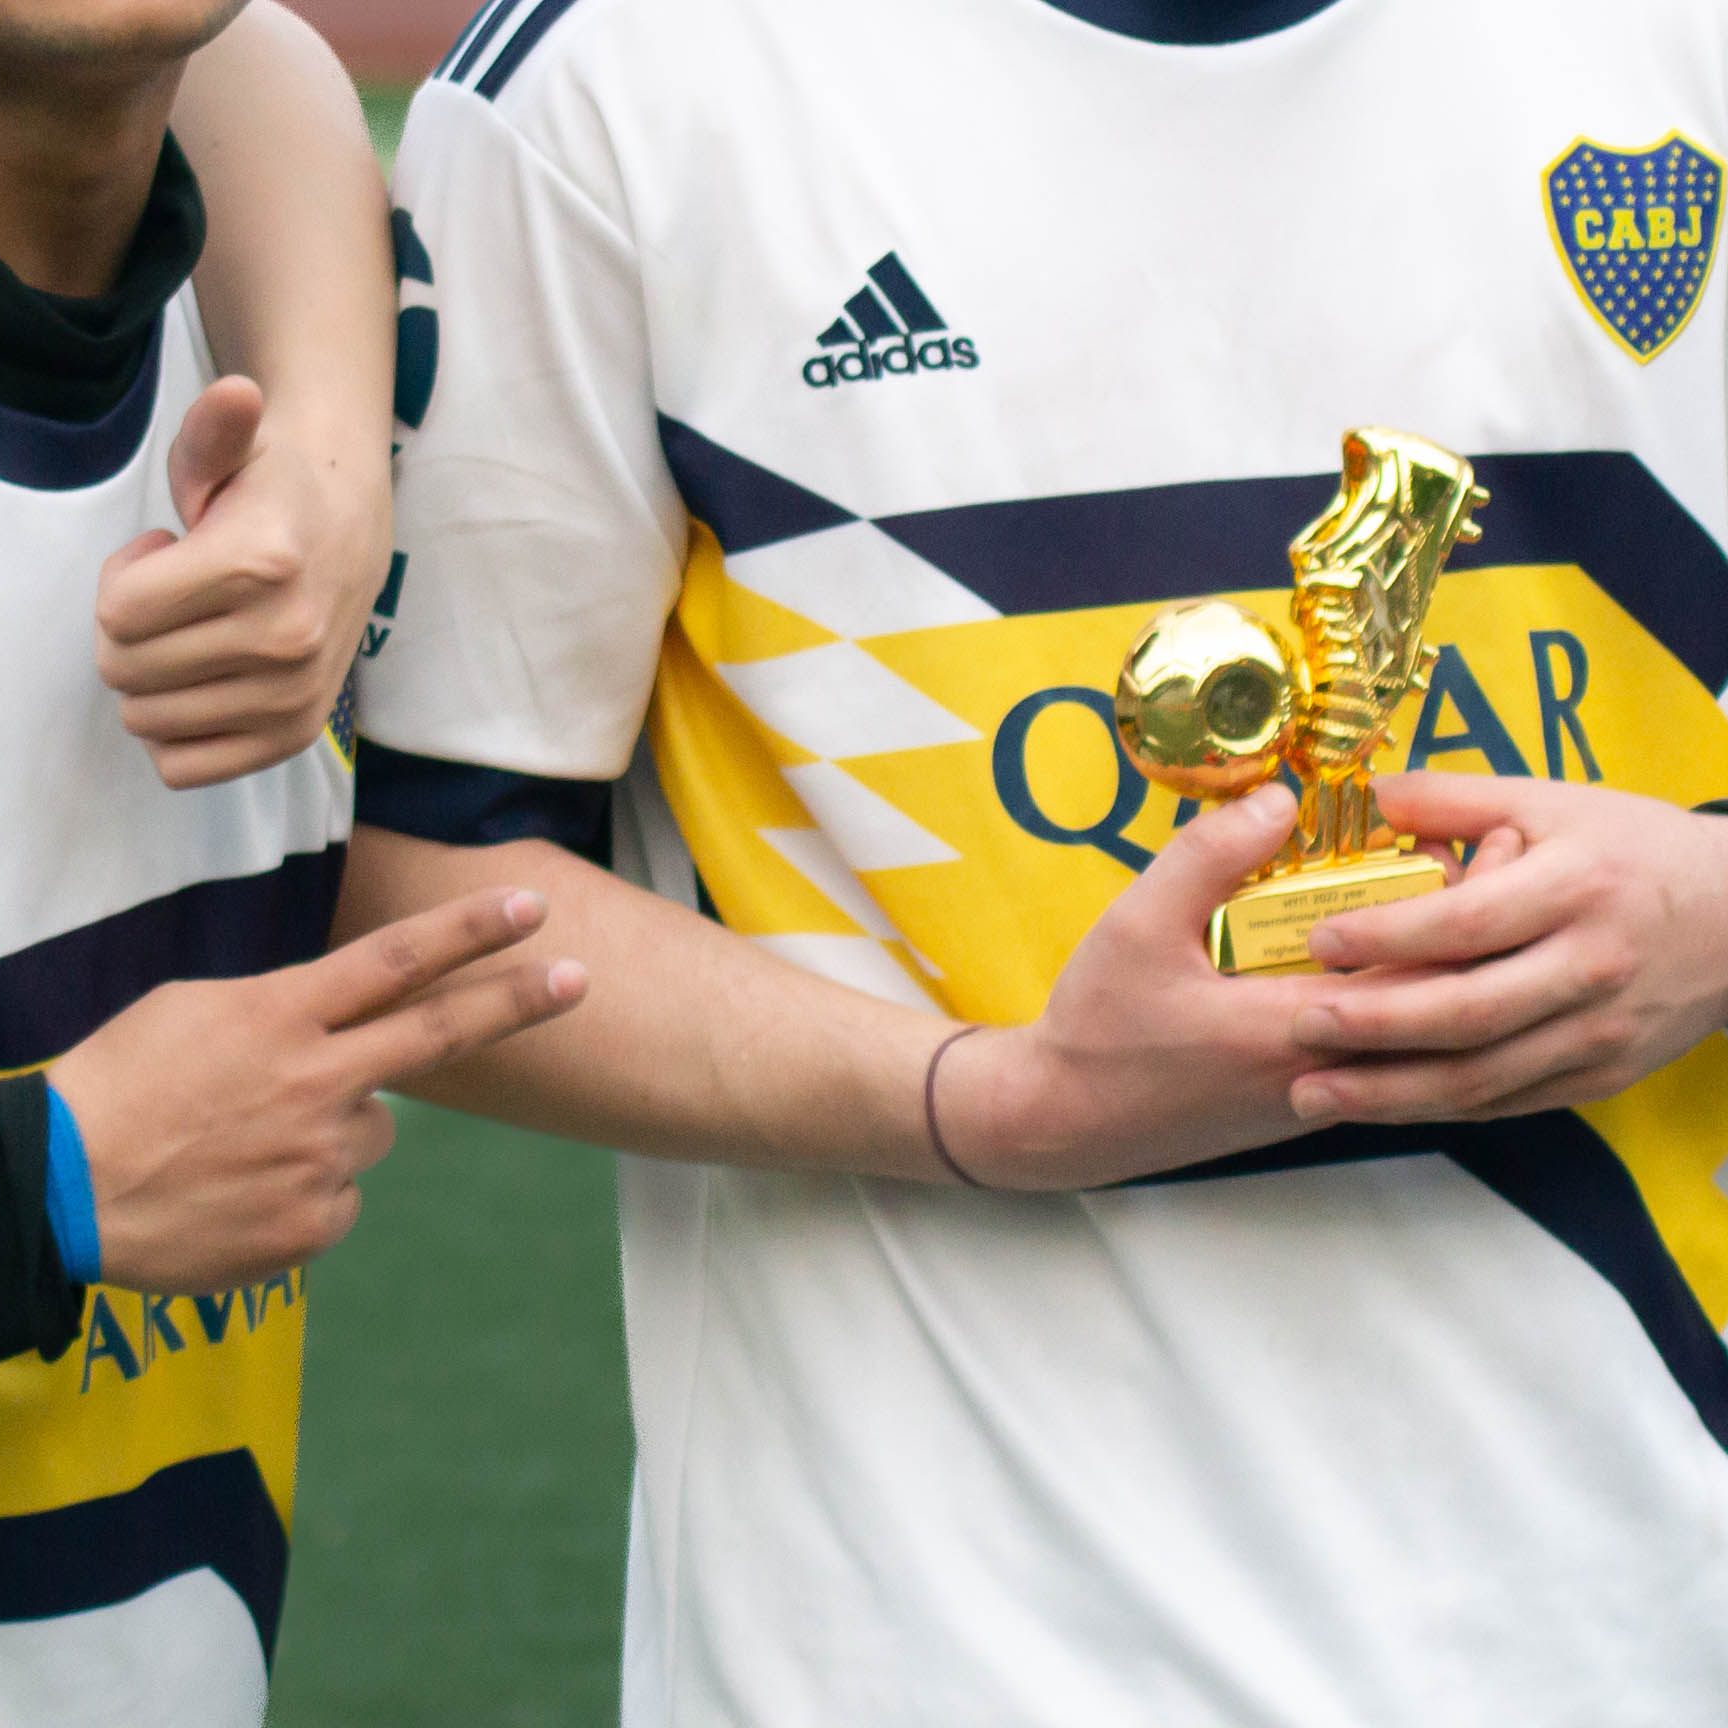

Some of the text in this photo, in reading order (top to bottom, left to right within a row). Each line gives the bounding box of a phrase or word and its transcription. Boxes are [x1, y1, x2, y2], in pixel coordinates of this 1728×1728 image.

[1574, 205, 1703, 250] CABJ
[802, 336, 980, 388] adidas
[991, 629, 1604, 874] QAR
